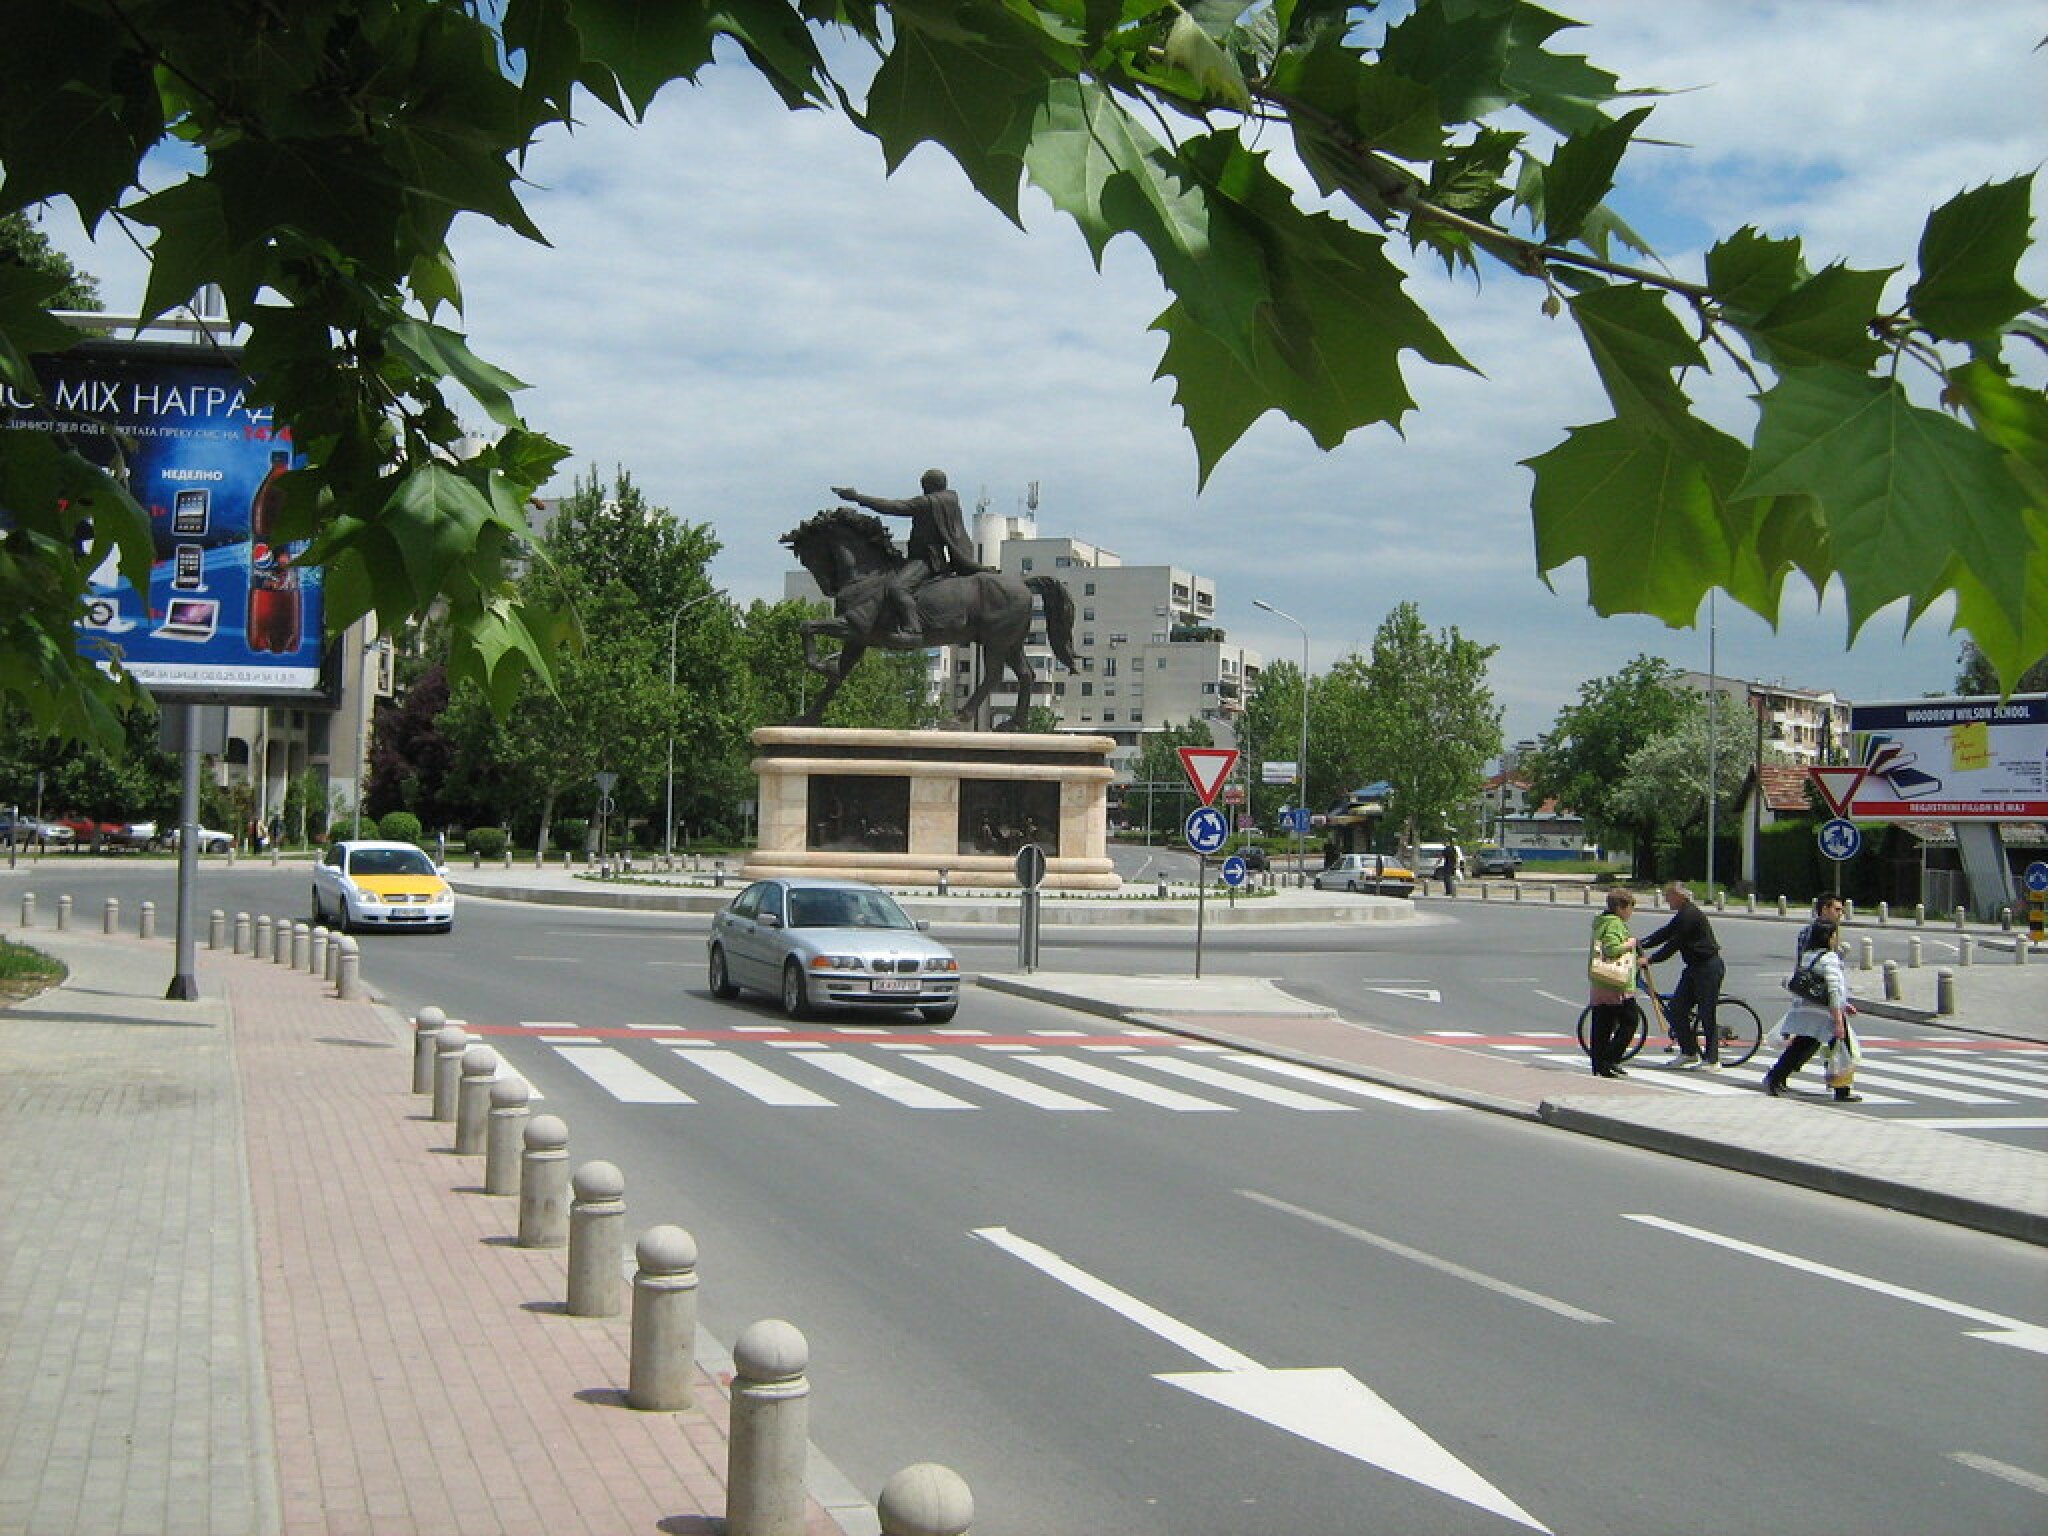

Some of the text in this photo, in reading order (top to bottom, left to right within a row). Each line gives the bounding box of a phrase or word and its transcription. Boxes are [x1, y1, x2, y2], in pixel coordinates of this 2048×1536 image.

[56, 380, 120, 411] MIX
[162, 469, 223, 481] НЕДЕЛНО
[1906, 706, 2030, 722] WOODROW WILSON SCHOOL
